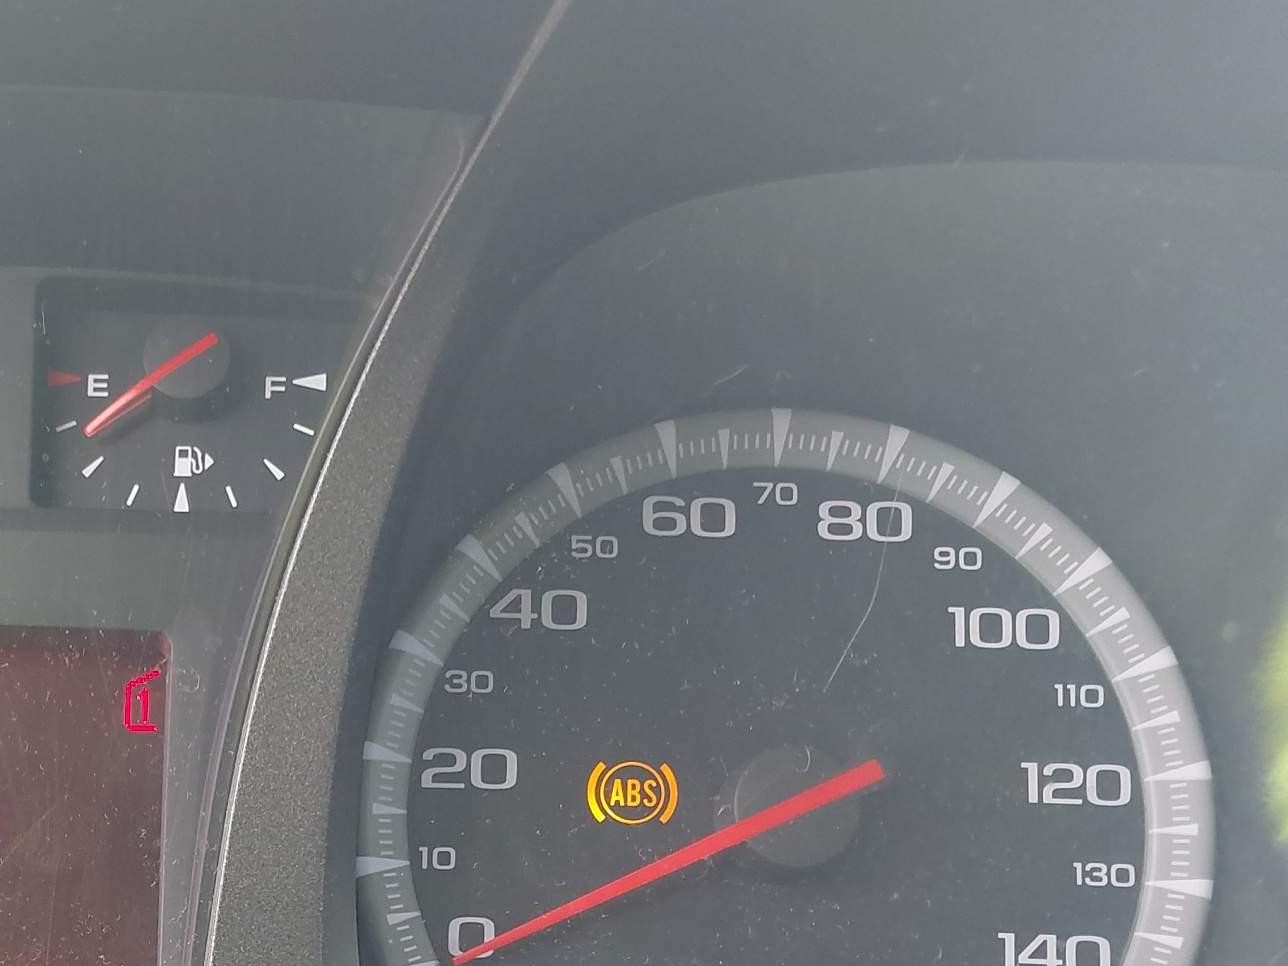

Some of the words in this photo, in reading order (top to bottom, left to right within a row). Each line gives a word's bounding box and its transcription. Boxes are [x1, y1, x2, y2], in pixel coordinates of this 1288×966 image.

[87, 374, 109, 397] E
[265, 376, 287, 399] F
[752, 482, 799, 506] 70
[641, 497, 736, 538] 60
[817, 501, 912, 543] 80
[570, 534, 619, 559] 50
[933, 546, 983, 571] 90
[489, 589, 588, 631] 40
[948, 607, 1060, 650] 100
[444, 670, 494, 695] 30
[1055, 684, 1105, 709] 110
[420, 748, 518, 790] 20
[610, 778, 658, 808] ABS
[1021, 762, 1132, 806] 120
[419, 847, 456, 871] 10
[1073, 863, 1136, 888] 130
[447, 918, 496, 961] 0
